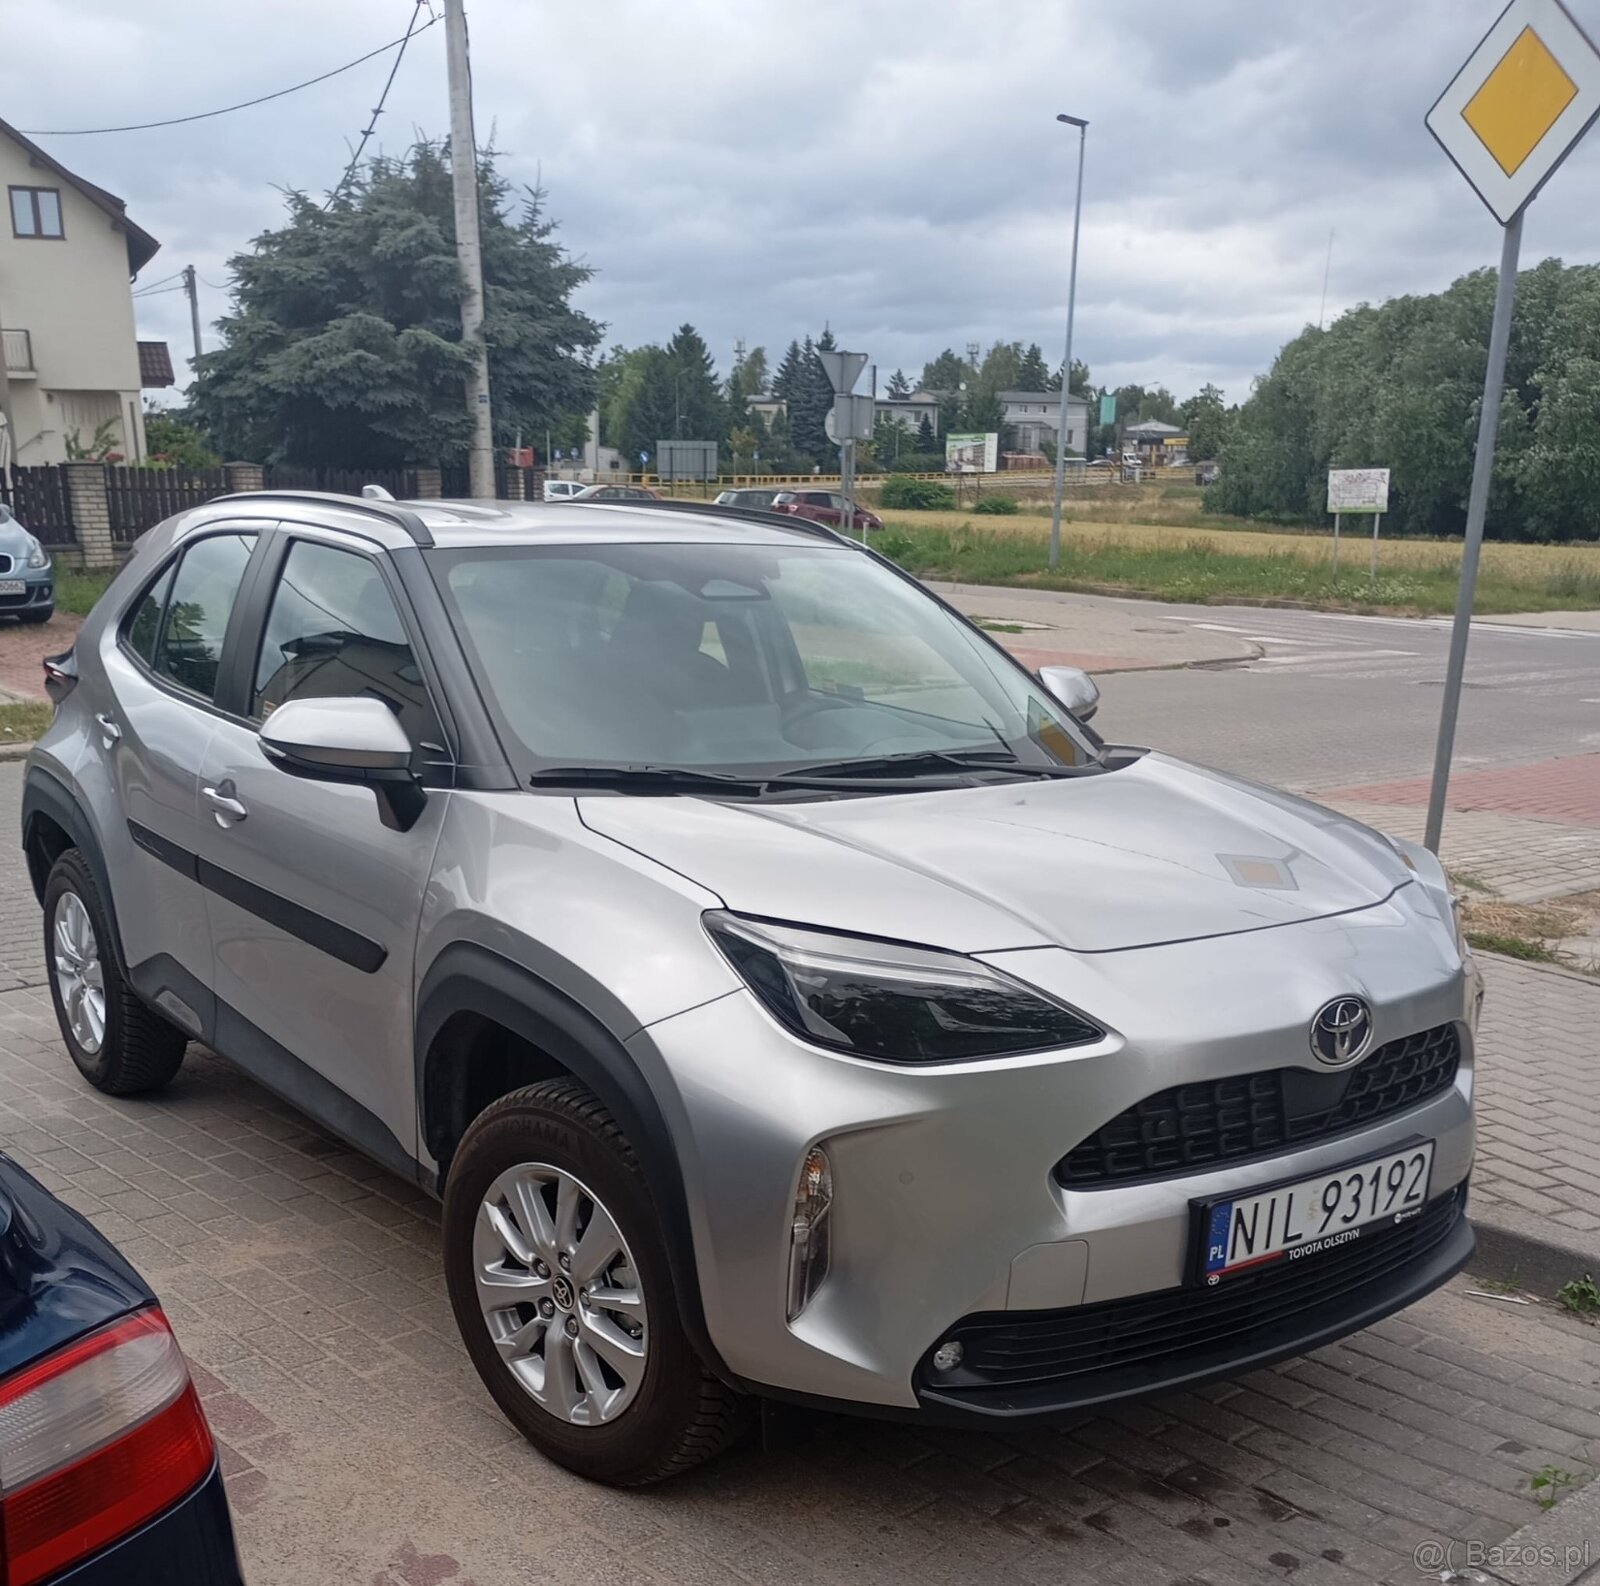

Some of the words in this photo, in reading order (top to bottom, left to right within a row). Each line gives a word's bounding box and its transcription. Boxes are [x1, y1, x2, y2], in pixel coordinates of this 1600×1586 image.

[1230, 1193, 1302, 1260] NIL
[1318, 1153, 1425, 1233] 93192
[1208, 1245, 1226, 1262] PL
[1288, 1243, 1323, 1261] TOYOTA
[1323, 1228, 1360, 1250] OLSZTYN
